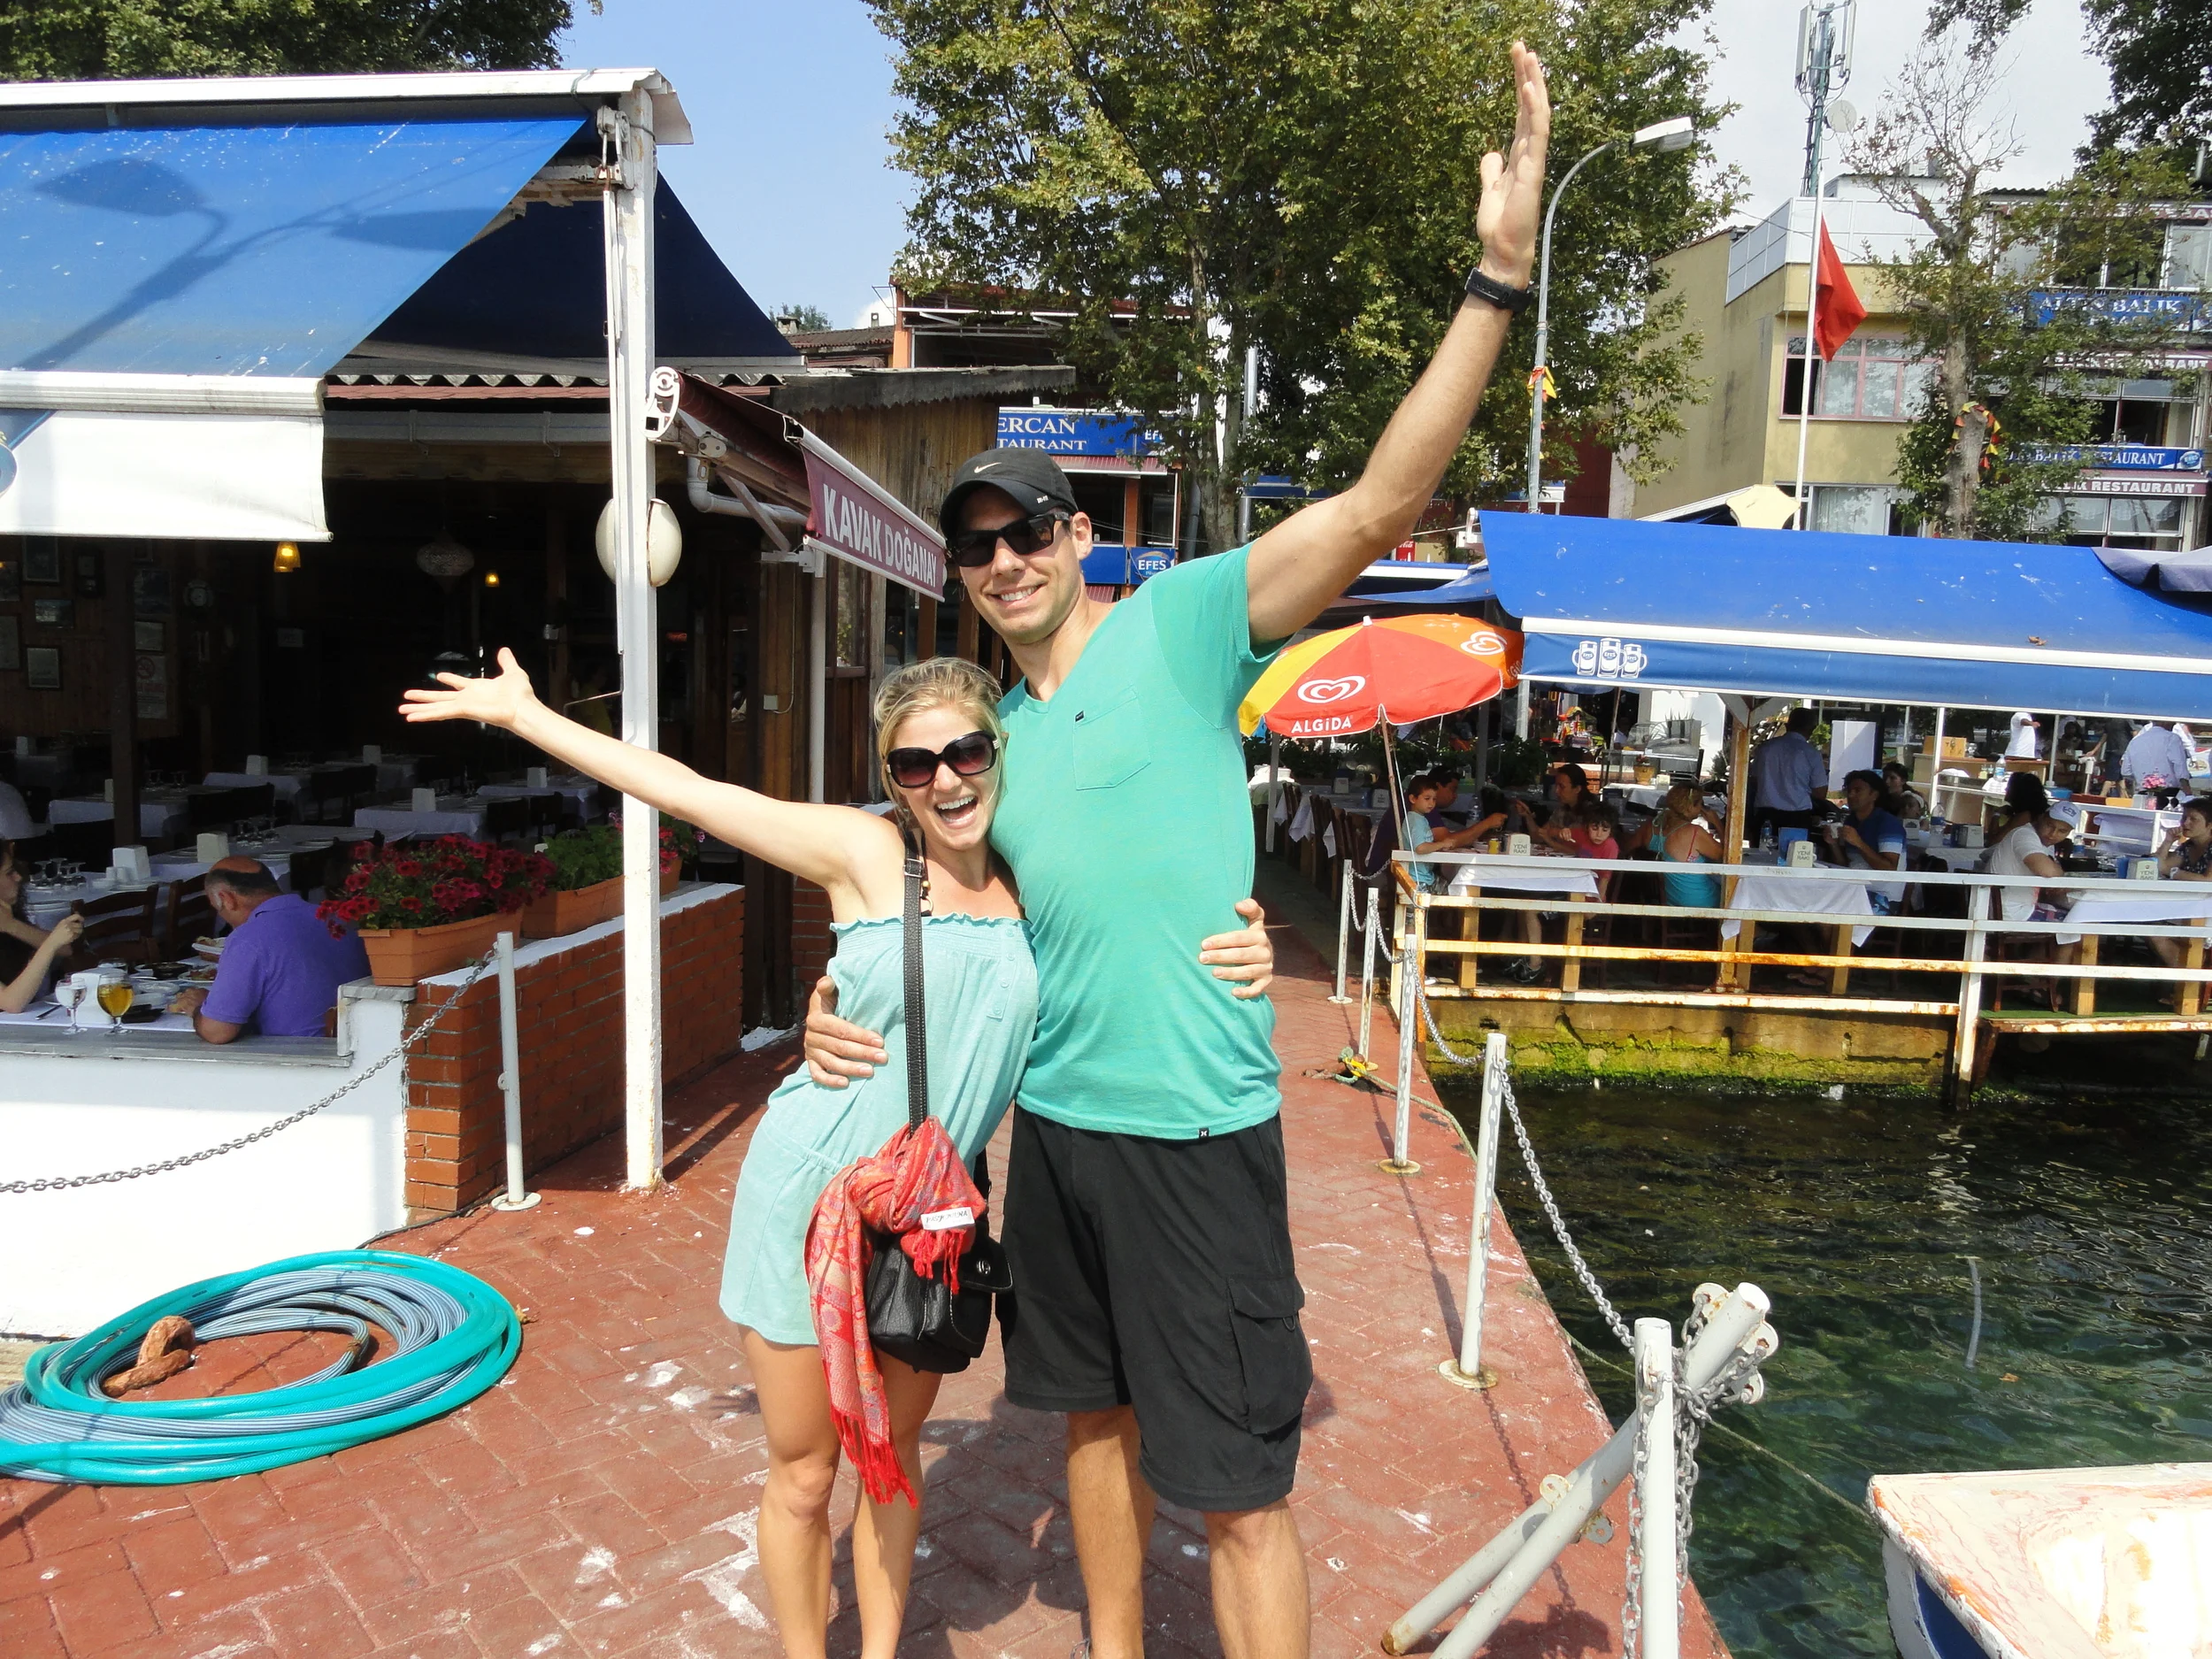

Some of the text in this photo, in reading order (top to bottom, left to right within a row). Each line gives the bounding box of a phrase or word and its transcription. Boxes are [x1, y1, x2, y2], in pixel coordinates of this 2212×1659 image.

[2092, 480, 2195, 494] RESTAURANT
[823, 483, 937, 588] KAVAK DOĞANAY
[1138, 559, 1166, 571] EFES
